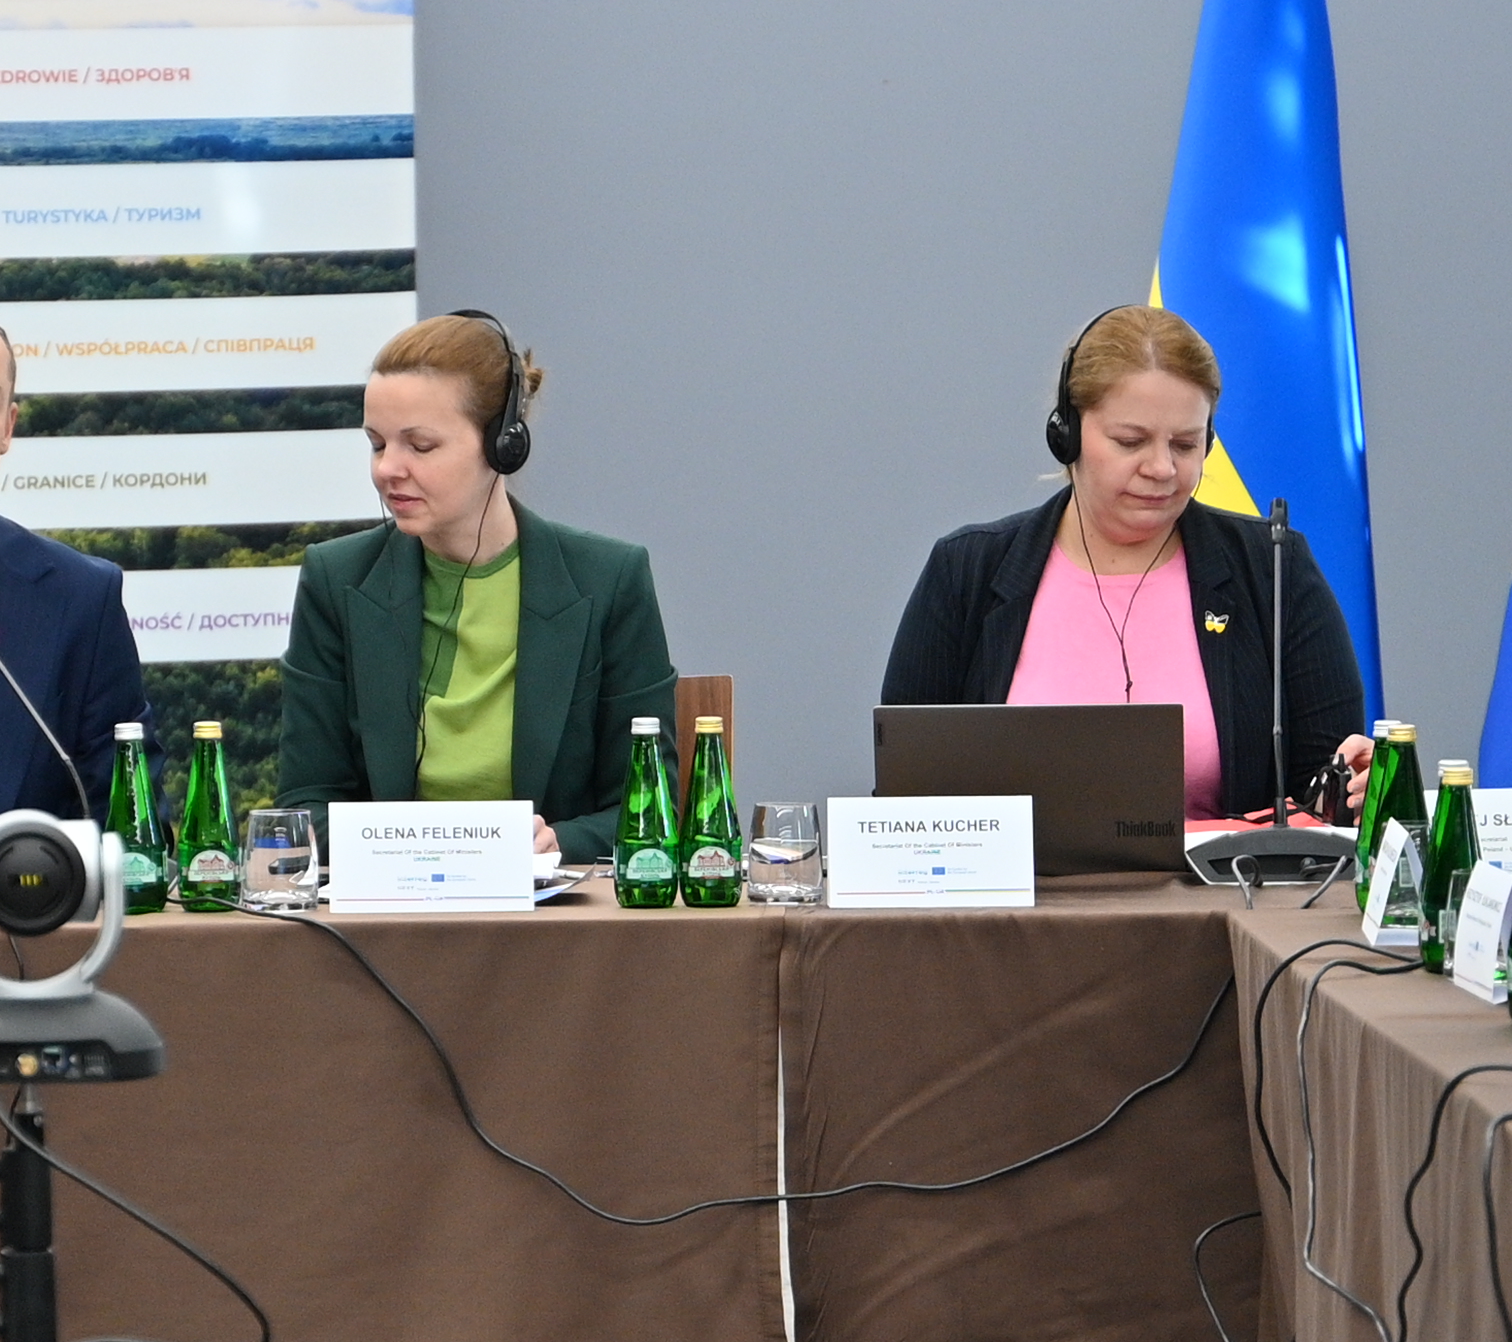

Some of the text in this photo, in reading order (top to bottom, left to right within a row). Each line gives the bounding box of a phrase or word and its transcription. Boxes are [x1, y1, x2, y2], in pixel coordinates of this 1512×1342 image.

[82, 66, 92, 85] /
[2, 208, 108, 225] TURYSTYKA
[112, 206, 122, 225] /
[125, 207, 202, 222] ТУРИЗМ
[56, 338, 188, 357] WSPÓŁPRACA
[192, 337, 201, 355] /
[204, 337, 316, 355] СПІВПРАЦЯ
[13, 474, 95, 490] GRANICE
[100, 471, 109, 489] /
[112, 472, 207, 489] КОРДОНИ
[198, 612, 290, 631] ДОСТУПН
[361, 827, 501, 840] OLENA FELENIUK
[858, 819, 1000, 834] TETIANA KUCHER
[1115, 820, 1176, 838] ThinkBook
